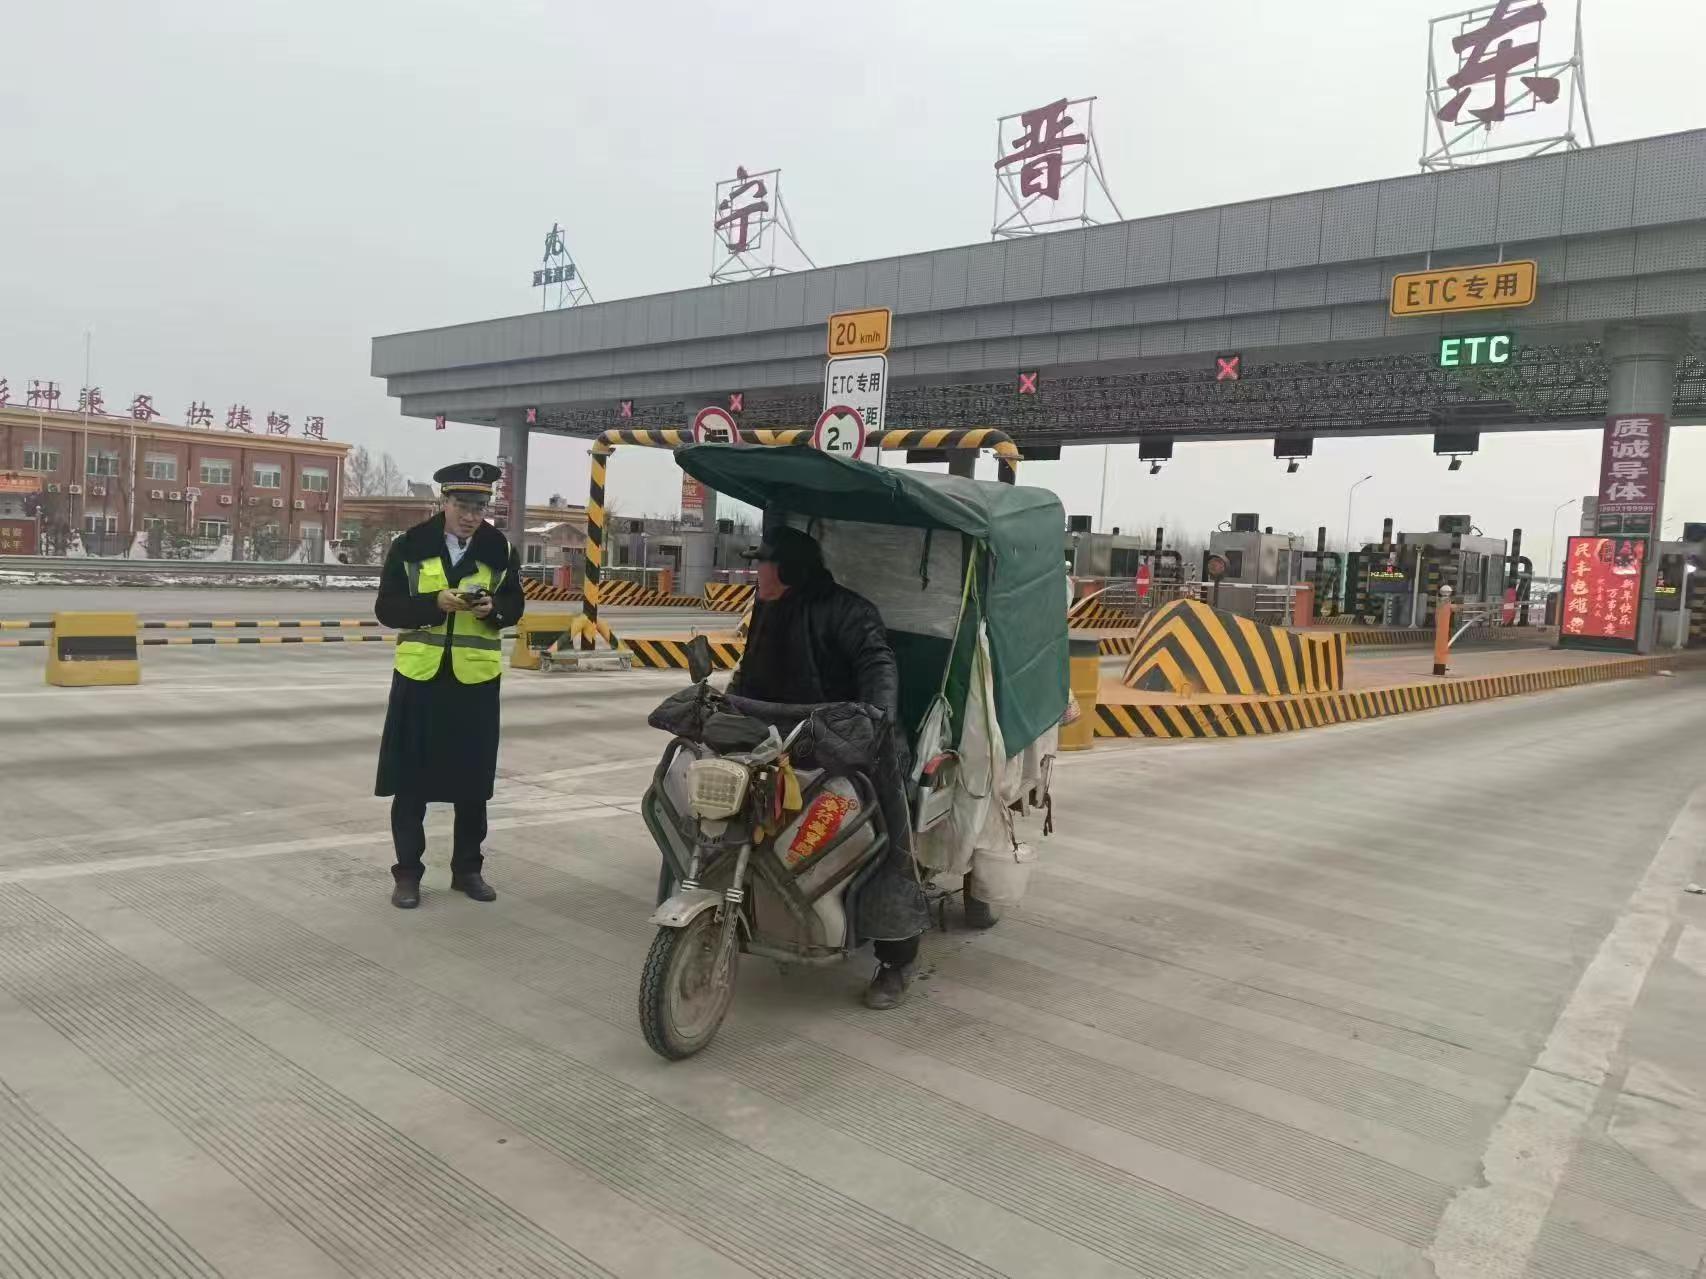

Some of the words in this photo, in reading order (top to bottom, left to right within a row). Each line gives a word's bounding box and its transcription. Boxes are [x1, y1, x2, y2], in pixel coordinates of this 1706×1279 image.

[714, 166, 769, 253] 宁
[995, 98, 1087, 201] 晋
[1436, 0, 1560, 122] 东
[1406, 273, 1518, 306] ETC专用
[836, 322, 857, 346] 20
[860, 330, 881, 343] km/h
[1440, 335, 1511, 366] ETC
[832, 373, 880, 394] ETC专用
[1606, 418, 1652, 501] 质诚导体
